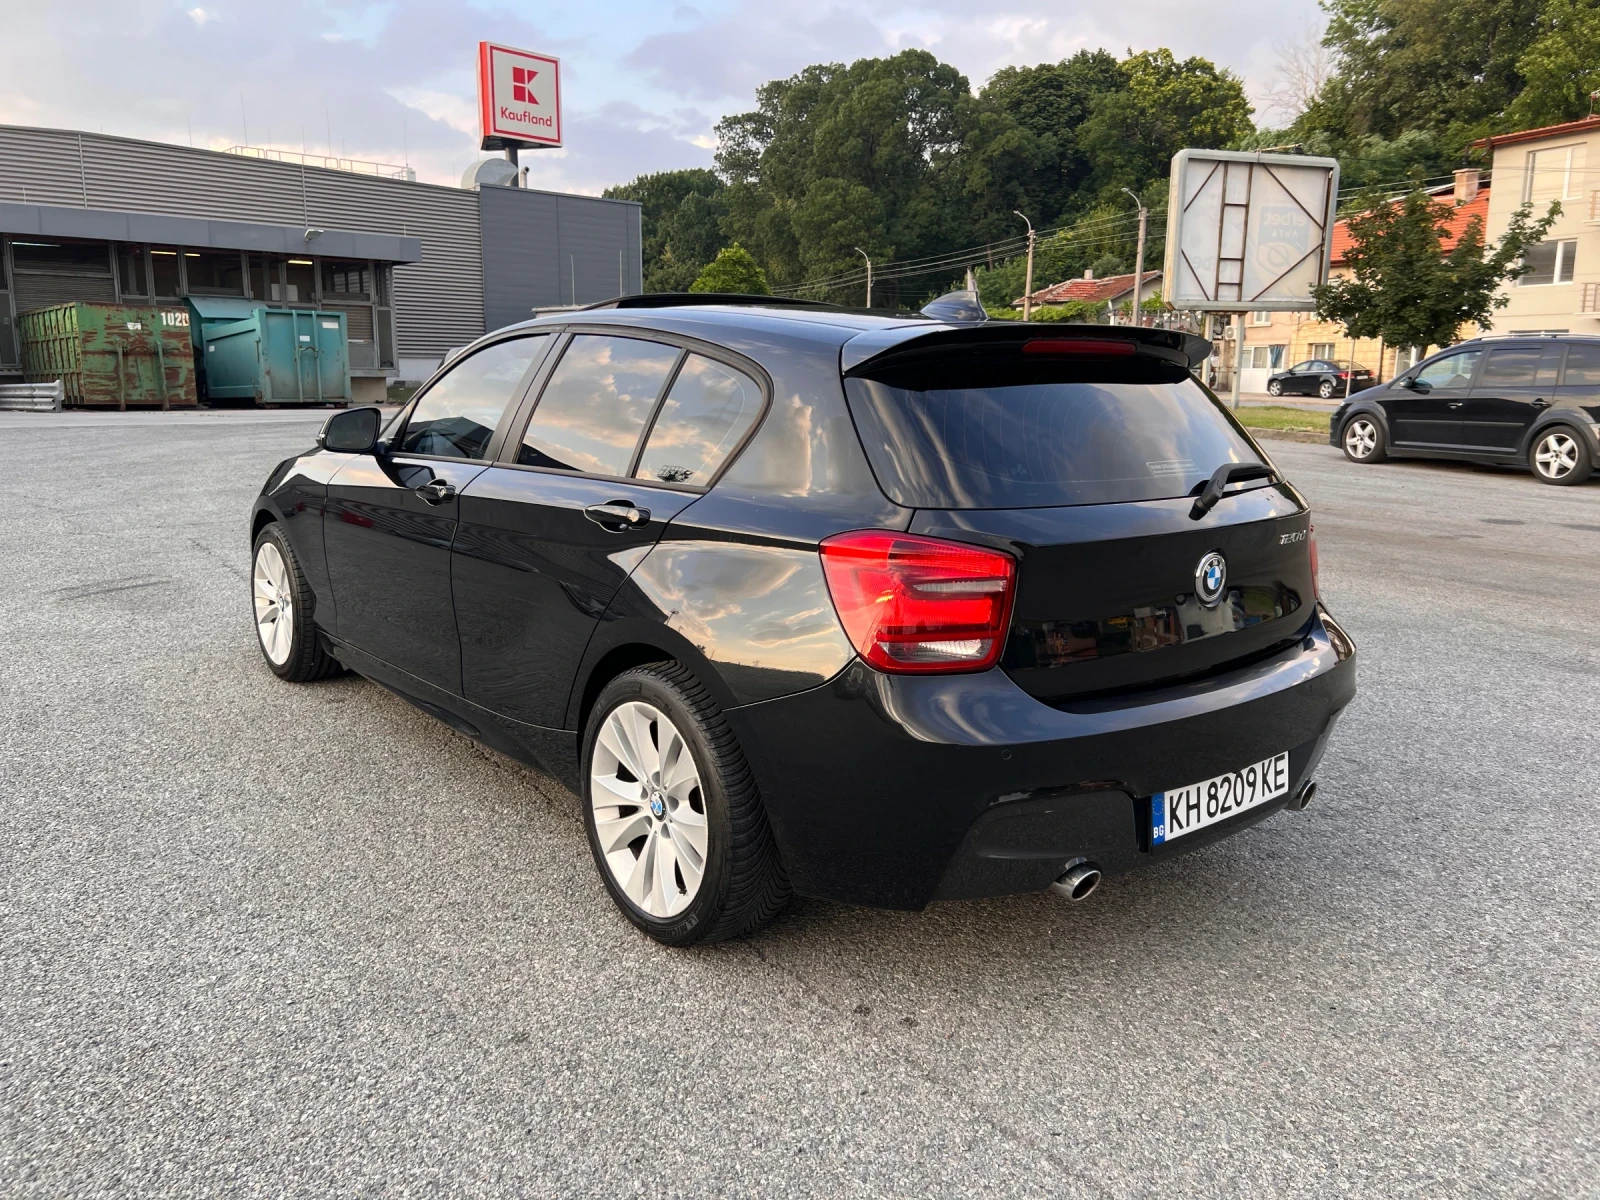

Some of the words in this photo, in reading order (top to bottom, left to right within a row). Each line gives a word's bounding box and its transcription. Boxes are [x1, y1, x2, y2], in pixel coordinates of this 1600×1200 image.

[501, 106, 552, 127] Kaufland
[1169, 786, 1200, 834] KH
[1206, 766, 1257, 818] 8209
[1261, 753, 1286, 797] KE
[1153, 825, 1164, 839] BG
